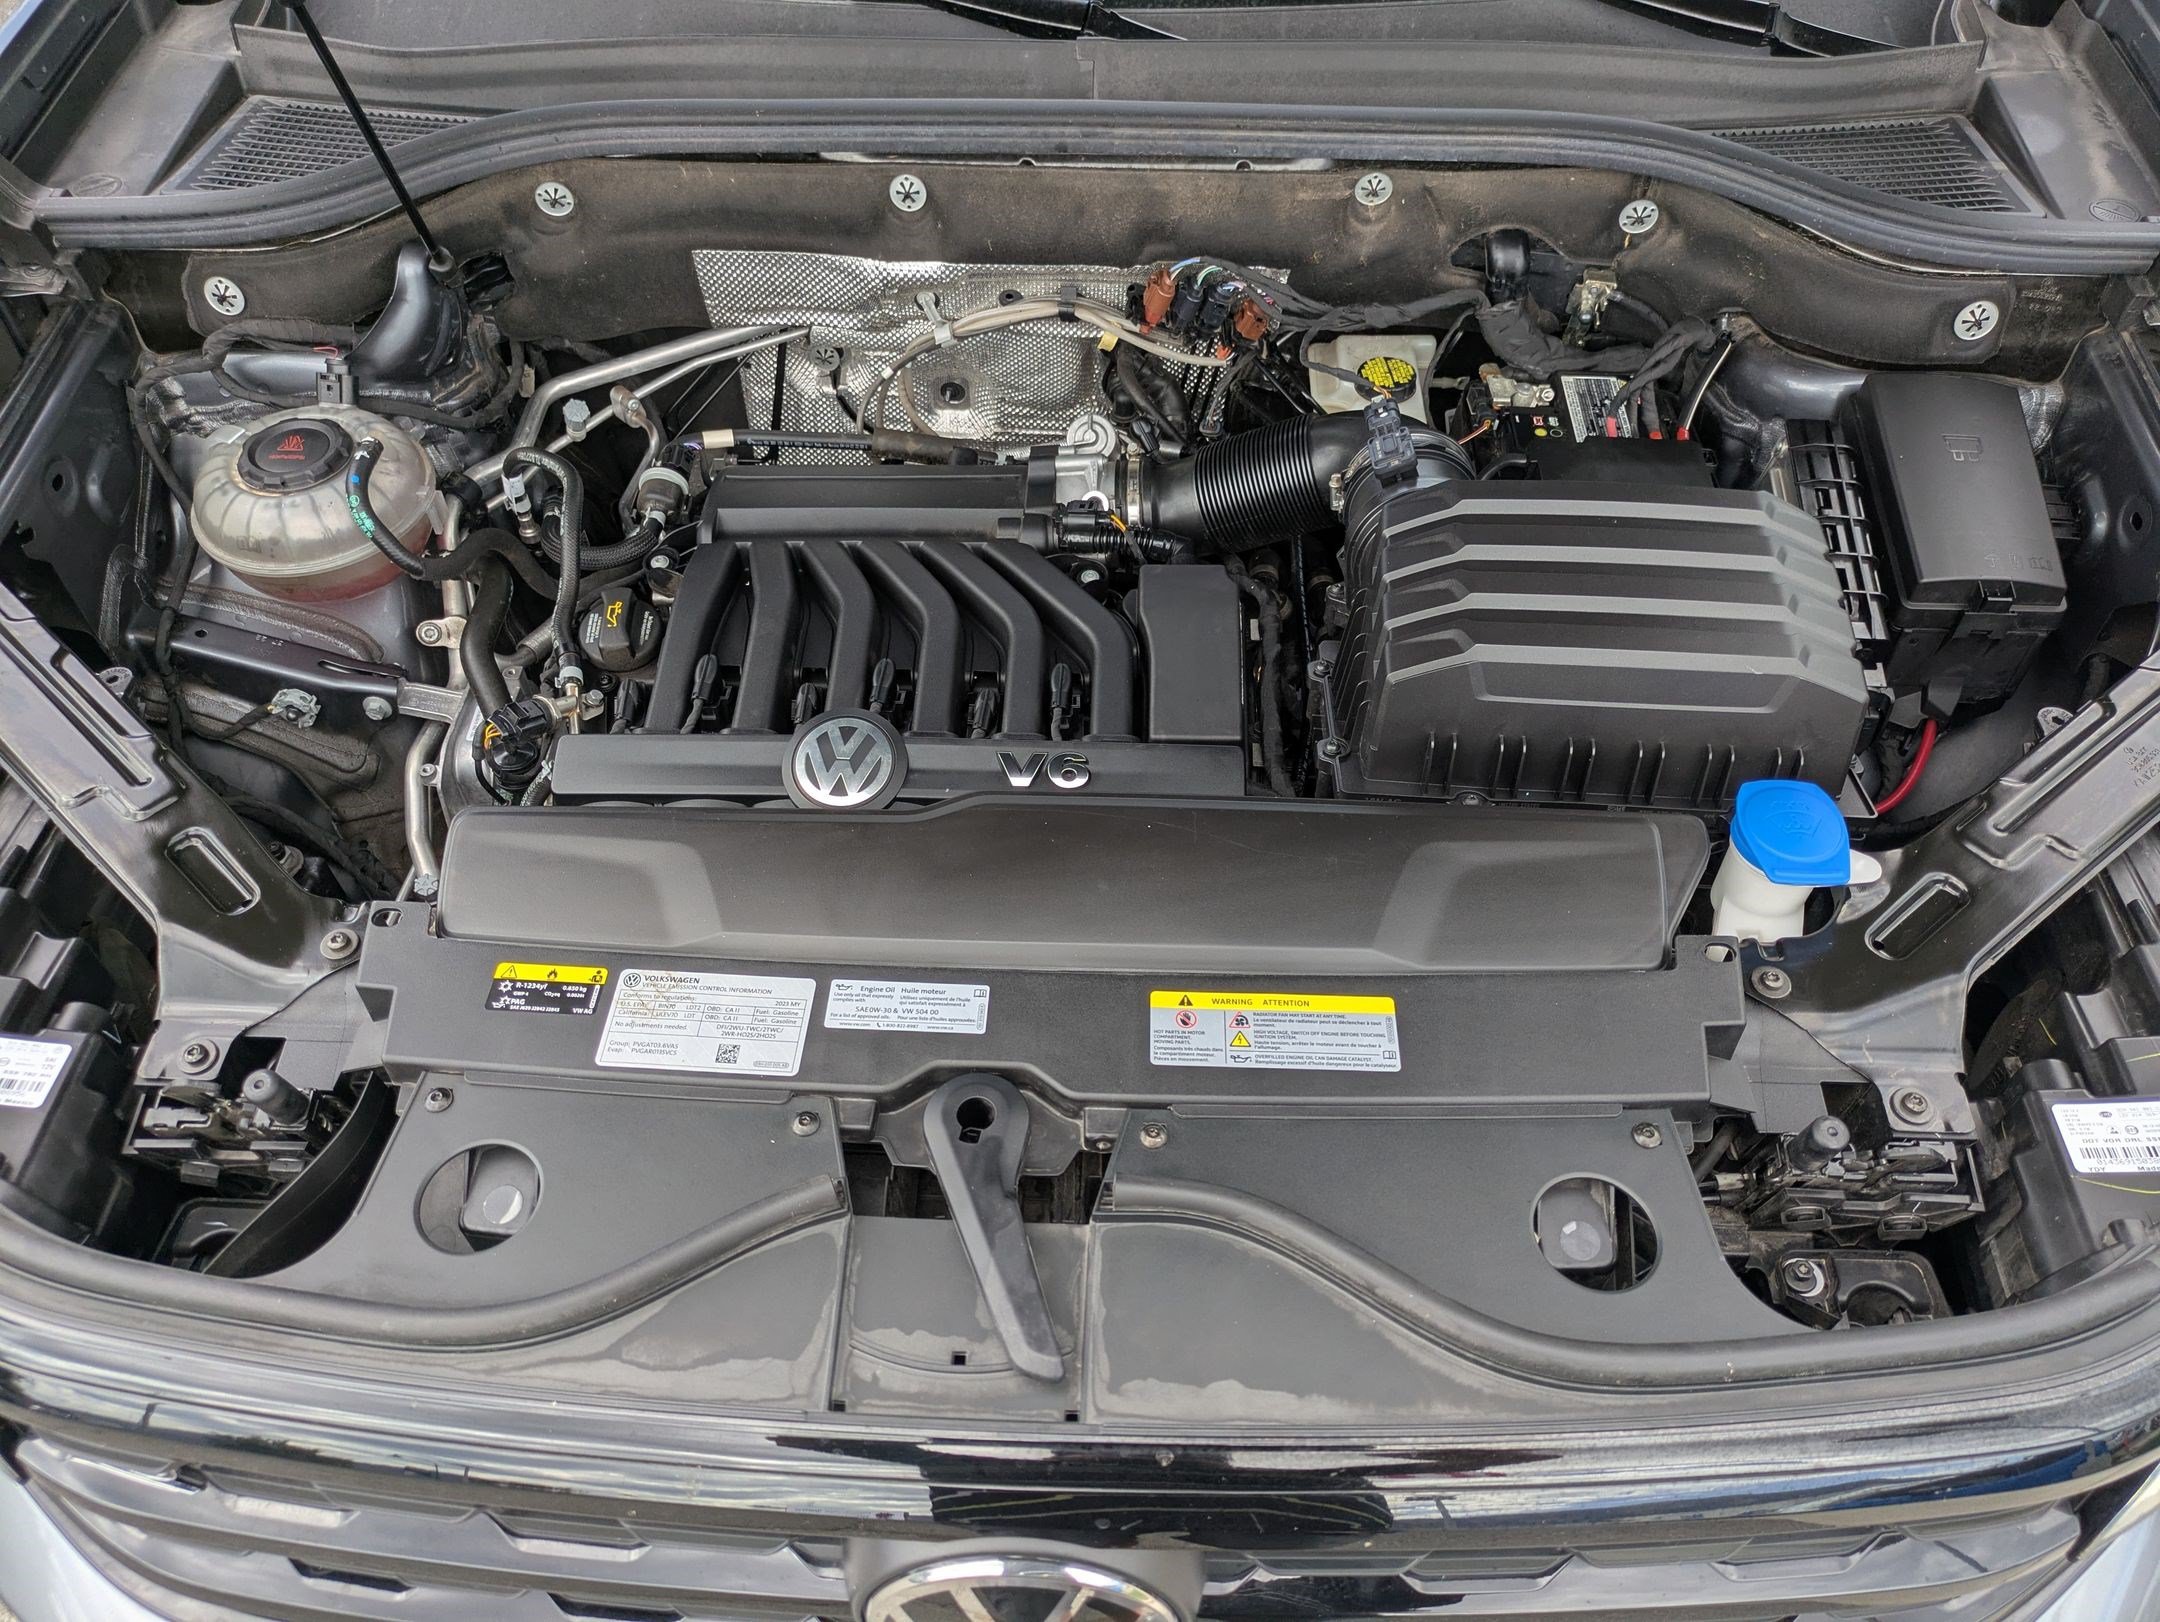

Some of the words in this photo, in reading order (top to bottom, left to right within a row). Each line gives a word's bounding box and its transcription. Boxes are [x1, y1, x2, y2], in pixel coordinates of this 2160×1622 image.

[997, 751, 1090, 789] V6
[644, 975, 700, 984] VOLKSWAGEN
[1212, 998, 1253, 1006] WARNING
[625, 1021, 663, 1030] adjustments
